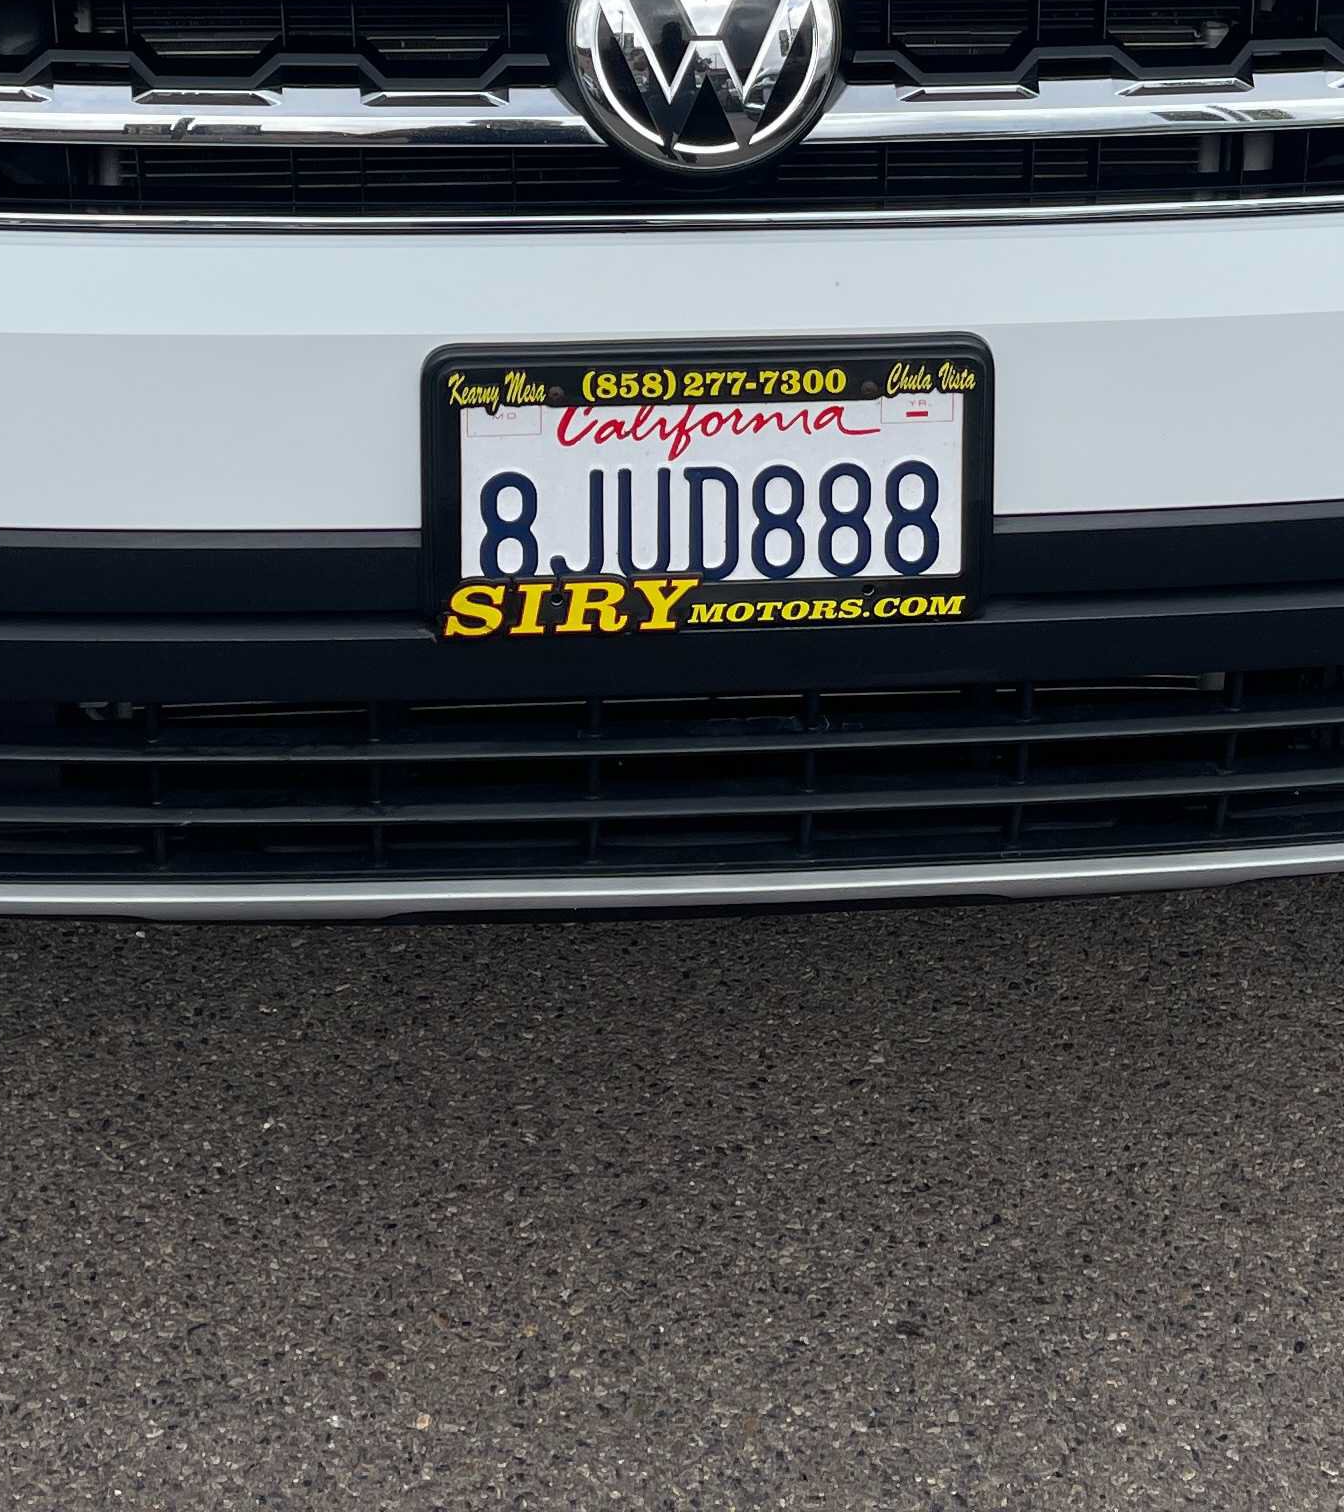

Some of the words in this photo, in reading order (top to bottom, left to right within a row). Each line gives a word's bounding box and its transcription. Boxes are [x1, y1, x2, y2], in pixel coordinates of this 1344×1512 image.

[447, 371, 500, 415] Kearny
[504, 370, 547, 405] Mesa
[582, 369, 678, 402] (858)
[682, 368, 848, 398] 277-7300
[886, 361, 933, 395] Chula
[938, 361, 977, 392] Vista
[556, 402, 882, 462] California
[479, 459, 941, 580] 8JUD888
[443, 575, 700, 638] SIRY
[687, 594, 966, 625] MOTORS.COM
